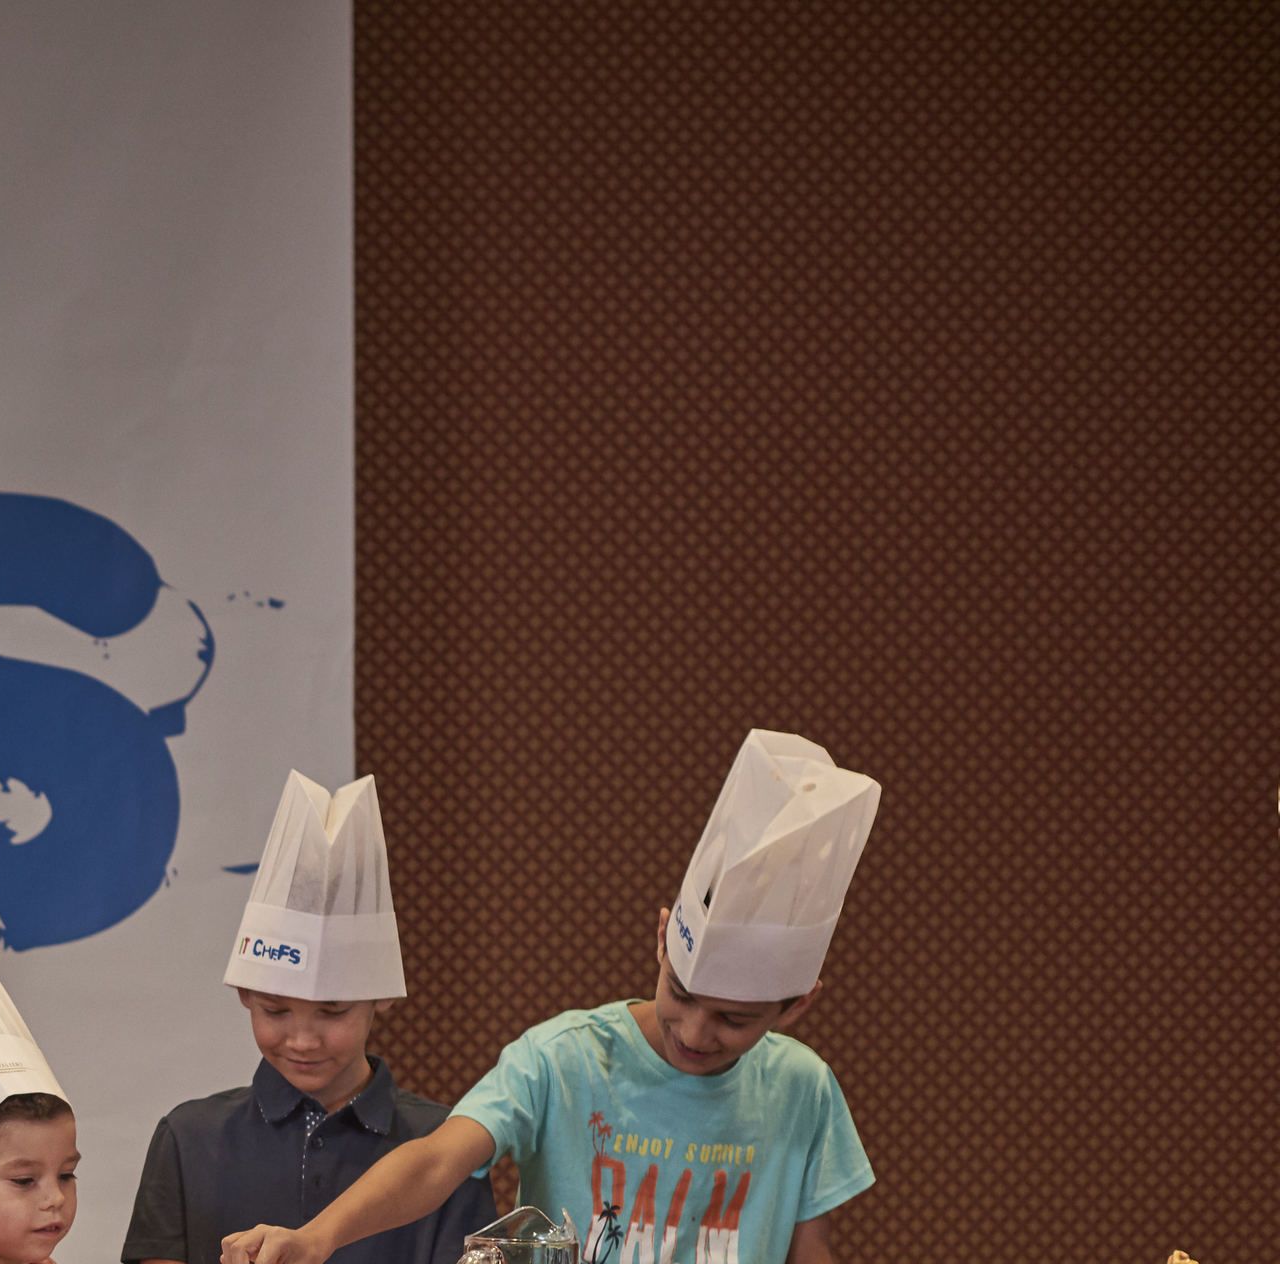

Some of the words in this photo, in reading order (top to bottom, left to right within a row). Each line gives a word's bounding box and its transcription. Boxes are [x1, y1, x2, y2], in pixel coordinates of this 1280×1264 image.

[239, 936, 251, 955] IT
[253, 938, 301, 965] CHEFS
[613, 1134, 674, 1160] ENJOY
